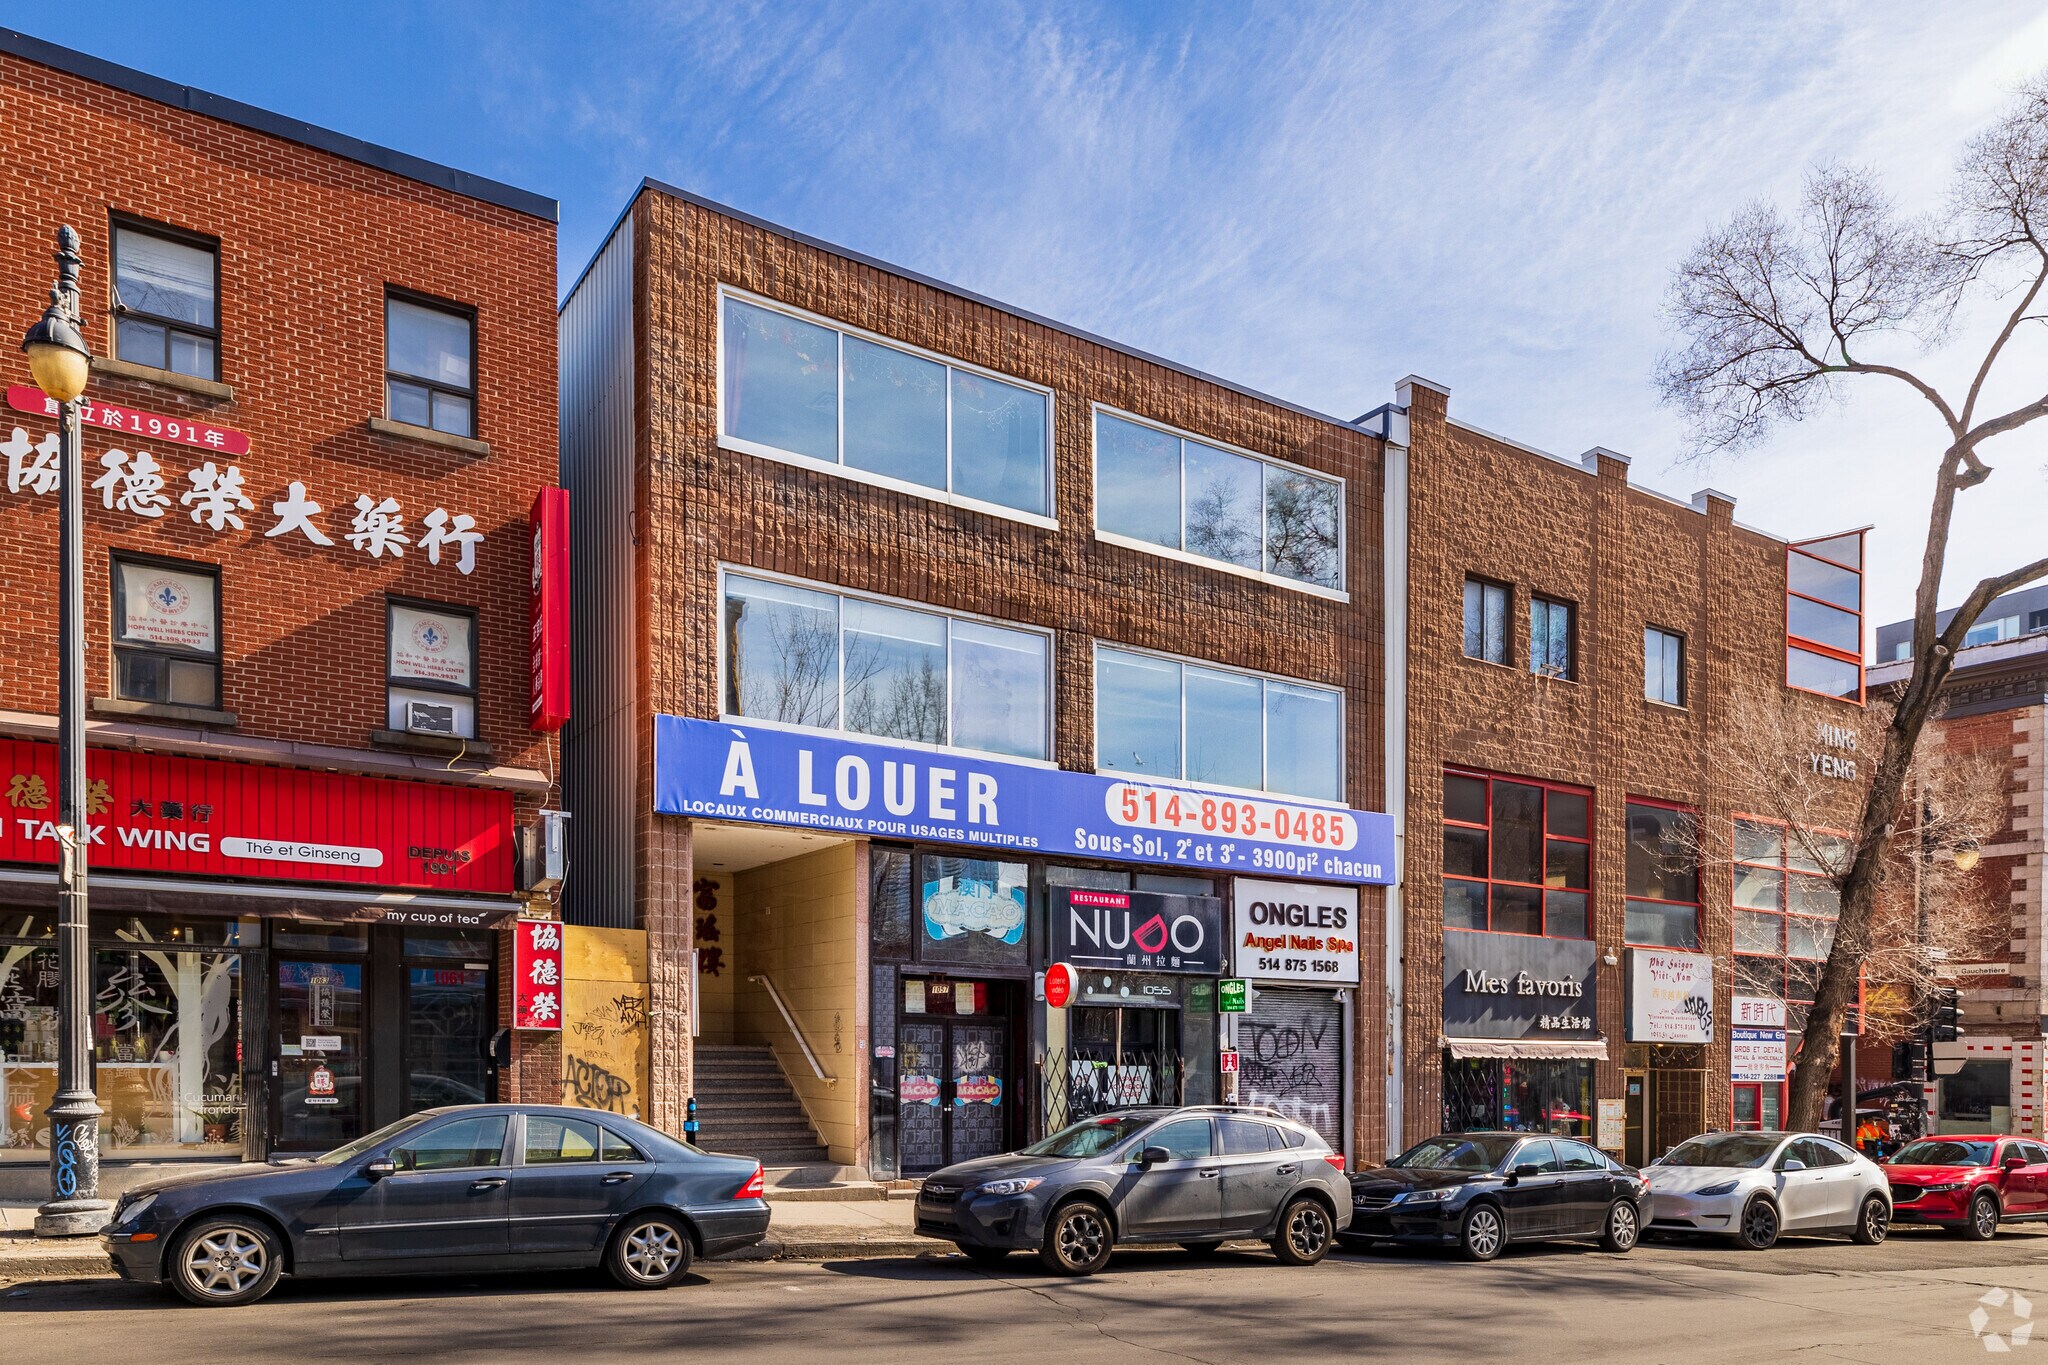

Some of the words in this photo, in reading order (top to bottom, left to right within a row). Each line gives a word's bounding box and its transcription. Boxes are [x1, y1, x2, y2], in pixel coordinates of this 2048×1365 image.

[719, 729, 759, 799] À
[798, 750, 999, 826] LOUER
[684, 800, 747, 817] LOCAUX
[751, 807, 863, 830] COMMERCIAUX
[867, 820, 906, 835] POUR
[910, 825, 965, 840] USAGES
[969, 831, 1039, 848] MULTIPLES
[1122, 788, 1344, 846] 514-893-0485
[117, 827, 210, 853] WING
[246, 841, 273, 855] Thé
[279, 845, 293, 856] et
[298, 846, 361, 863] Ginseng
[408, 845, 472, 862] DEPUIS
[1074, 827, 1168, 859] Sous-Sol,
[1195, 845, 1213, 862] et
[1324, 856, 1382, 879] chacun
[421, 862, 457, 875] 1991
[933, 898, 1020, 921] MACAO
[1074, 894, 1126, 905] RESTAURANT
[387, 911, 407, 923] my
[410, 912, 437, 924] cup
[439, 911, 454, 923] of
[457, 912, 480, 925] tea
[1249, 901, 1348, 929] ONGLES
[1070, 907, 1205, 953] NUDO
[1243, 932, 1287, 953] Angel
[1289, 935, 1324, 951] Nails
[1326, 937, 1354, 954] Spa
[1259, 958, 1281, 970] 514
[1285, 959, 1307, 971] 875
[1311, 960, 1339, 972] 1568
[1143, 985, 1172, 995] 1055
[1221, 982, 1244, 994] ONGLES
[1465, 969, 1508, 994] Mes
[1518, 970, 1582, 997] favoris
[1741, 1002, 1777, 1022] 新時代
[1732, 1031, 1758, 1040] Boutique
[1734, 1045, 1750, 1053] GROS
[958, 1085, 1000, 1095] MACAO
